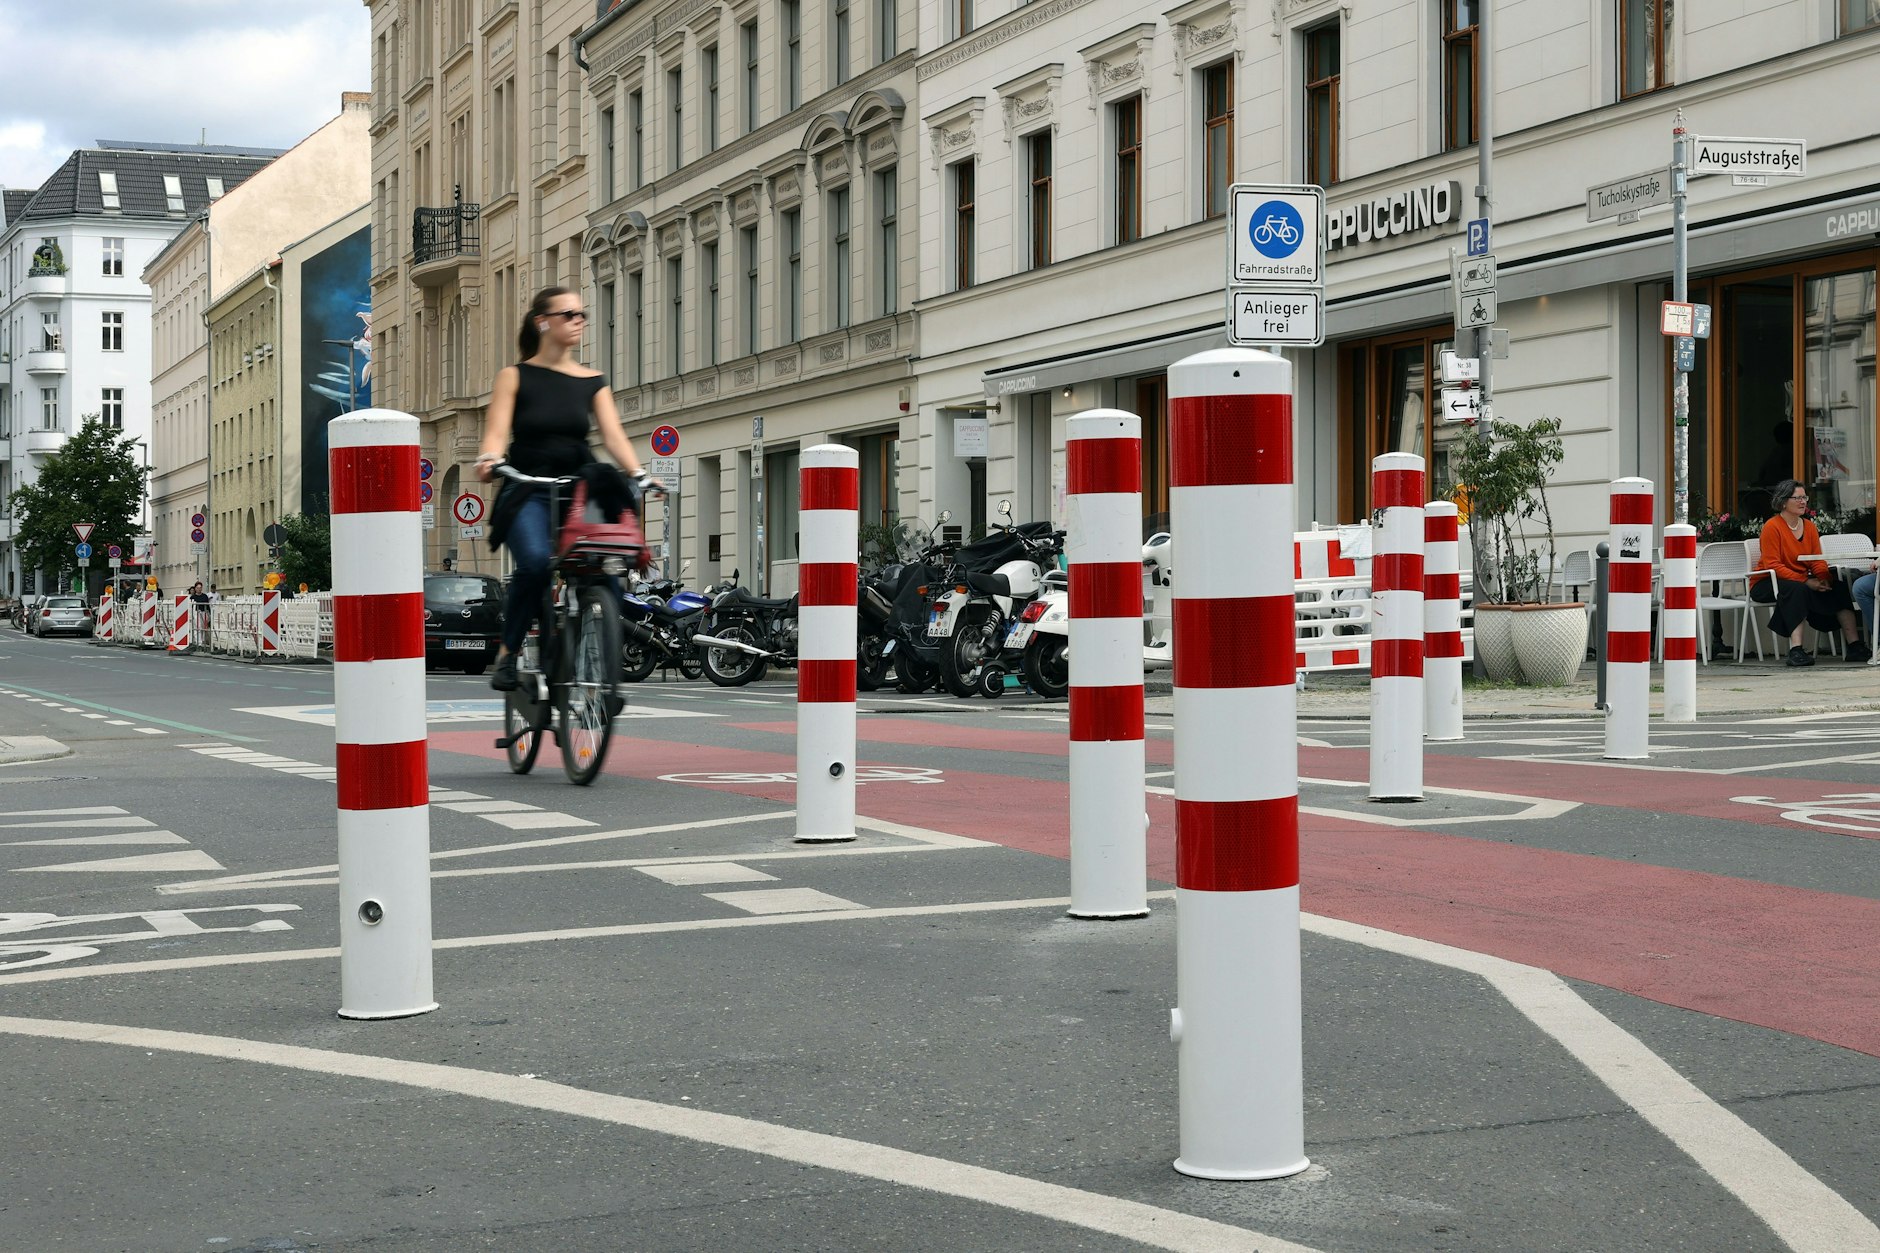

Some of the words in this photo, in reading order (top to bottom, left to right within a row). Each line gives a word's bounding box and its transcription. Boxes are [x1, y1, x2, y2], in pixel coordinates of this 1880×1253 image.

[1699, 146, 1800, 170] Auguststraße
[1596, 177, 1660, 209] Tucholskystraße
[1325, 180, 1451, 252] PPUCCINO
[1826, 207, 1880, 238] CAPPU
[1239, 263, 1313, 275] Fahrradstraße
[1243, 300, 1309, 318] Anlieger
[1263, 319, 1290, 333] frei
[998, 375, 1036, 394] CAPPUCCINO
[450, 640, 455, 648] B
